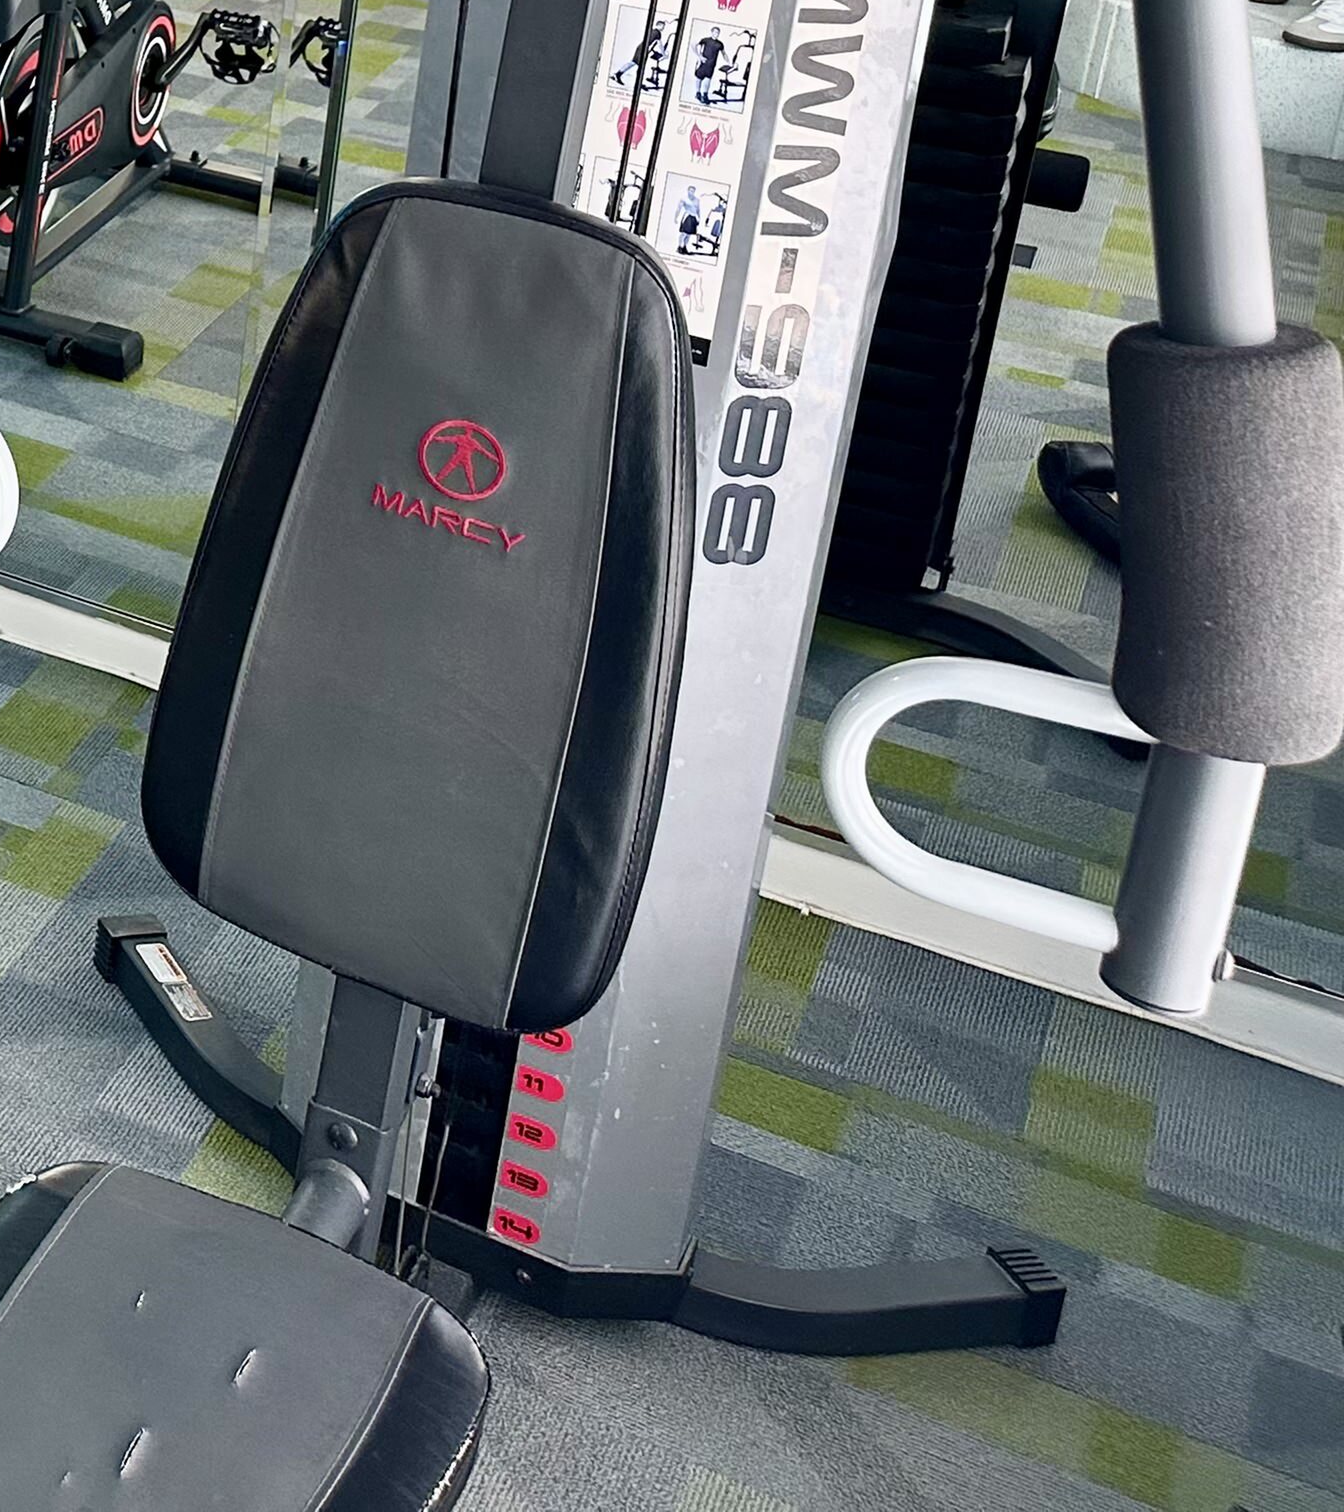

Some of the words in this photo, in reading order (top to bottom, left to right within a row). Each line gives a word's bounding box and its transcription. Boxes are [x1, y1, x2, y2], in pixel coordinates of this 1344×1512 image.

[371, 483, 527, 553] MARCY
[522, 1072, 544, 1092] 11
[515, 1120, 544, 1144] 12
[507, 1168, 540, 1192] 13
[498, 1214, 533, 1239] 14
